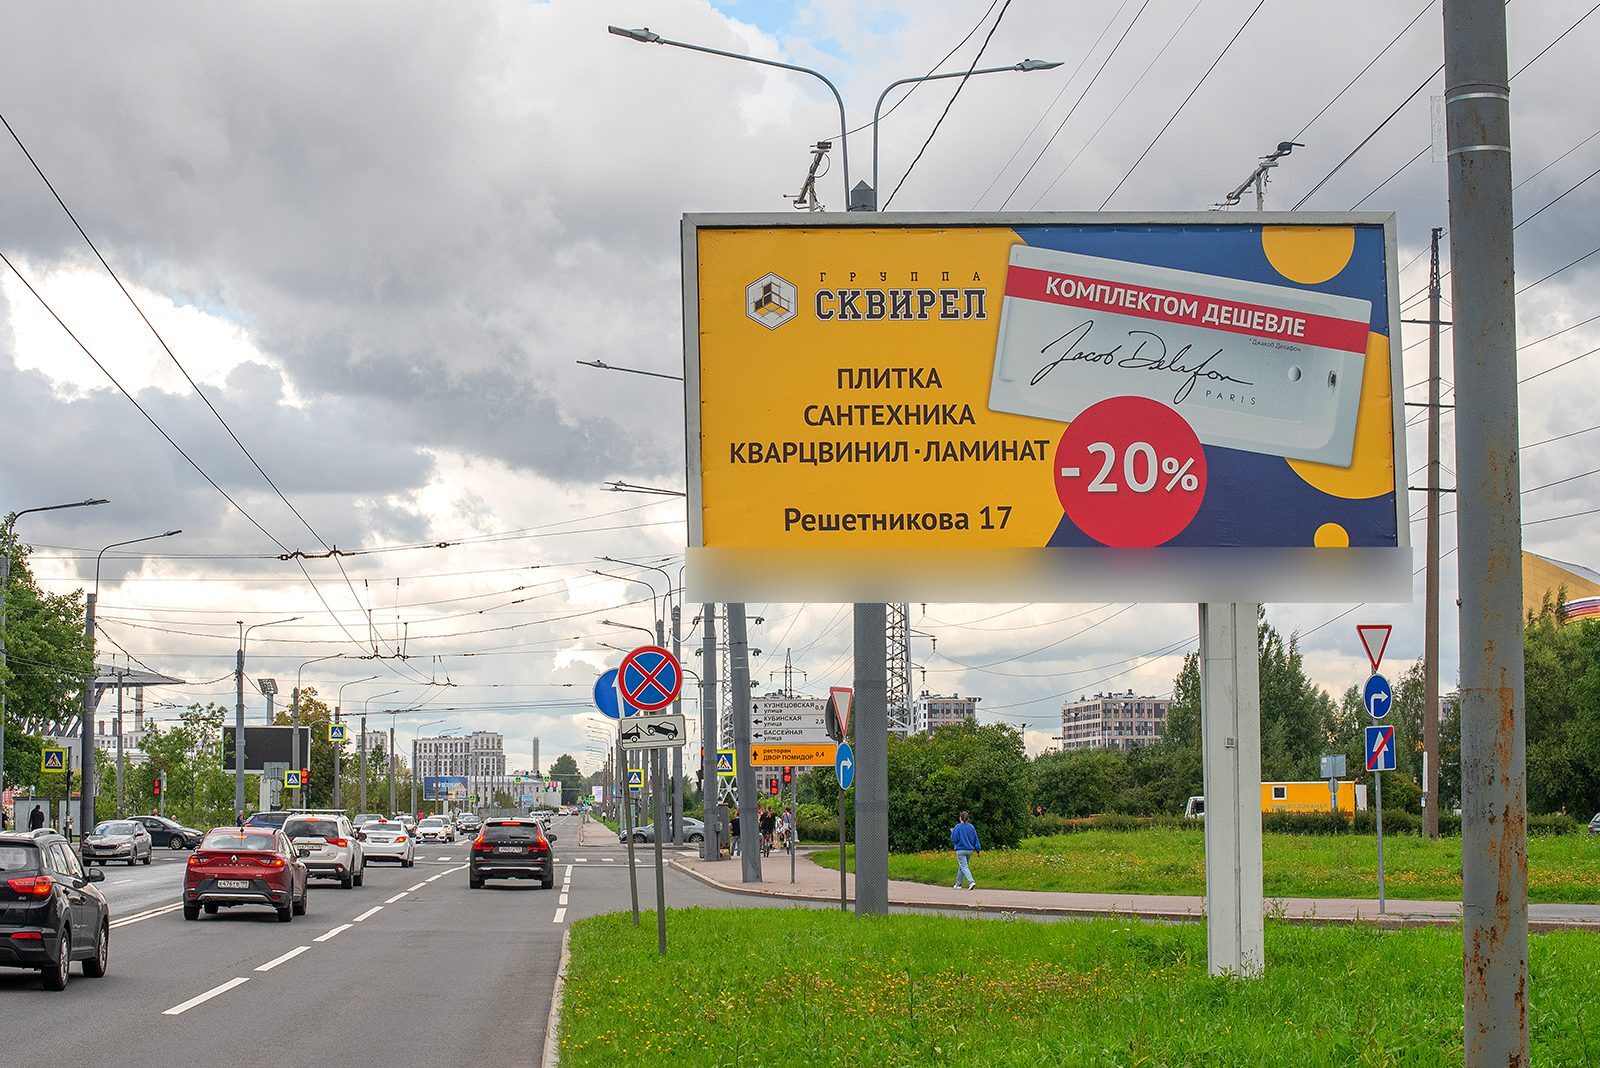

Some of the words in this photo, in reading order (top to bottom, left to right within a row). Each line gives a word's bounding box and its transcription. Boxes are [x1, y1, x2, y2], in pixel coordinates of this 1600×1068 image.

[814, 288, 988, 321] СКВИРЕЛ
[1045, 275, 1199, 319] КОМПЛЕКТОМ
[1202, 302, 1307, 338] ДЕШЕВЛЕ
[1030, 320, 1118, 387] Jacob
[1118, 331, 1255, 405] Delafon
[837, 367, 943, 390] ПЛИТКА
[1205, 389, 1257, 406] PARIS
[803, 404, 977, 426] САНТЕХНИКА
[730, 441, 909, 466] КВАРЦВИНИЛ
[922, 439, 1051, 463] ЛАМИНАТ
[1061, 441, 1199, 494] -20%
[784, 507, 970, 532] Решетникова
[979, 506, 1013, 530] 17
